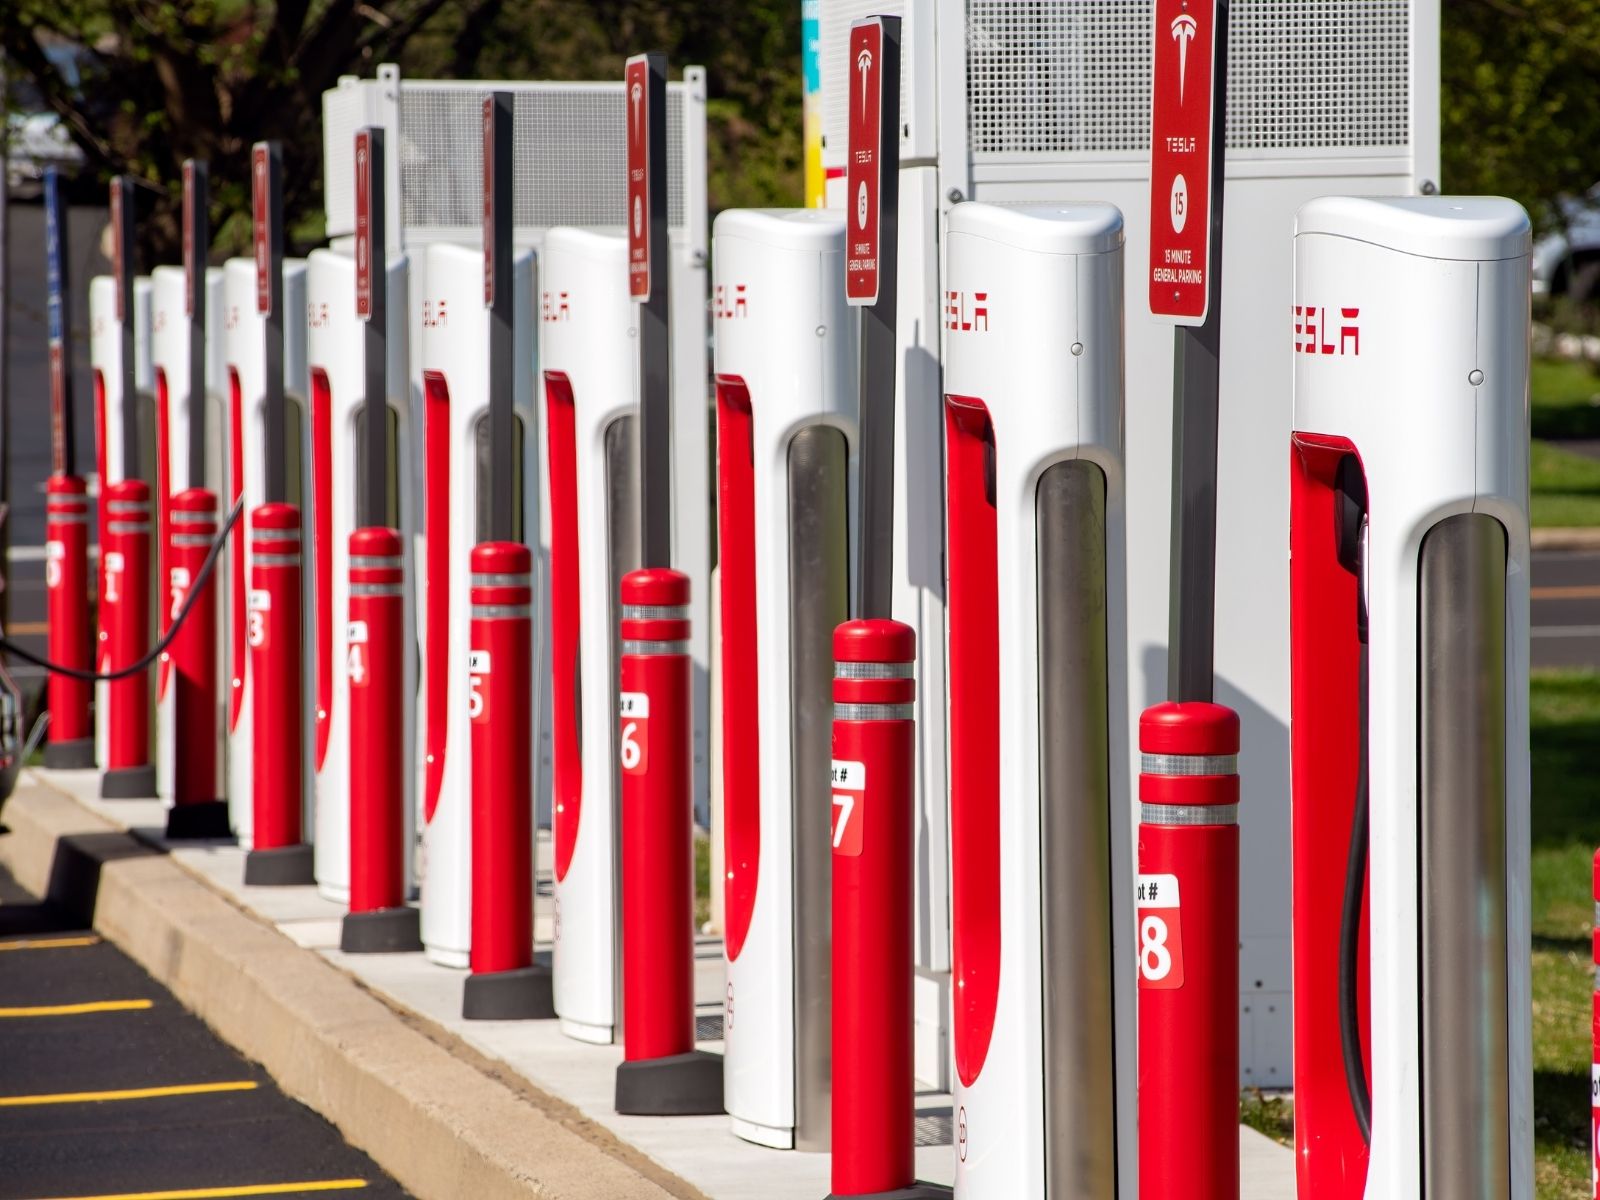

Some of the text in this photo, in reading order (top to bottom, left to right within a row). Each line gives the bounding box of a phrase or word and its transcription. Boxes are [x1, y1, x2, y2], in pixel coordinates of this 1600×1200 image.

[1166, 137, 1196, 153] TESLA
[1174, 192, 1184, 216] 15
[1165, 249, 1192, 264] 15 MINUTE
[1153, 267, 1202, 284] GENERAL PARKING
[1293, 305, 1360, 356] ESLA
[621, 721, 641, 769] 6
[831, 794, 855, 848] 7
[1137, 882, 1158, 900] ot #
